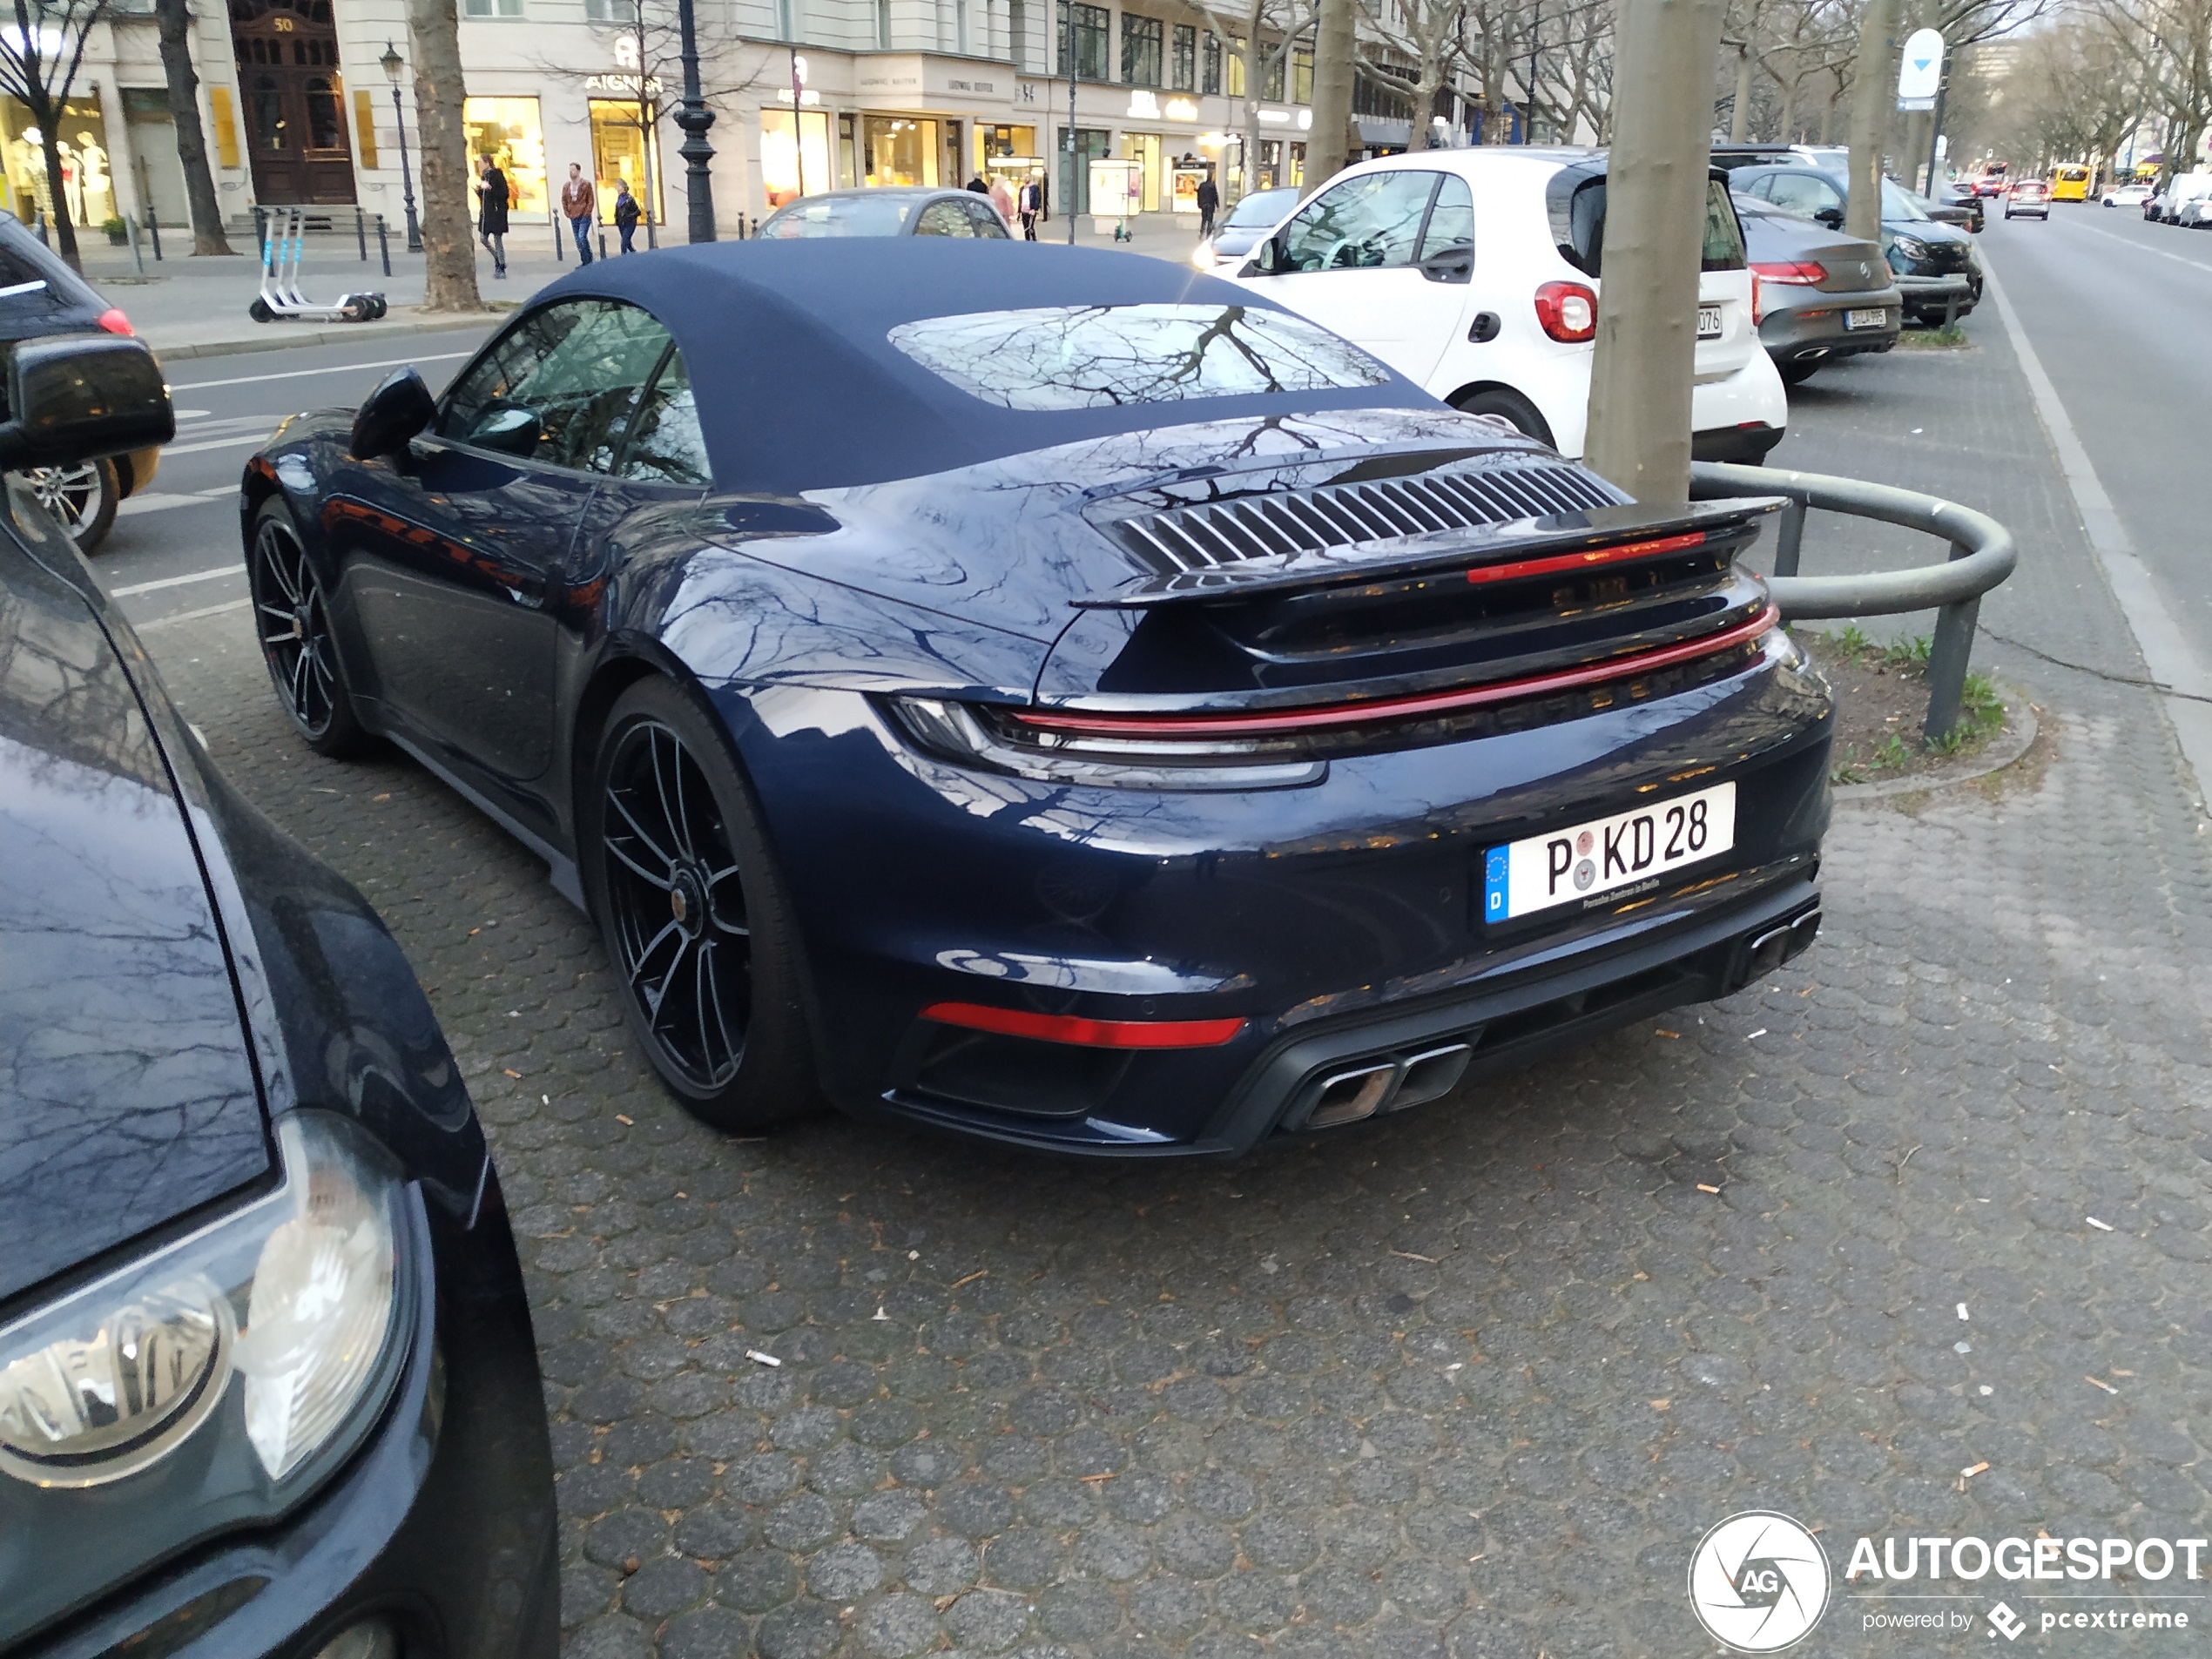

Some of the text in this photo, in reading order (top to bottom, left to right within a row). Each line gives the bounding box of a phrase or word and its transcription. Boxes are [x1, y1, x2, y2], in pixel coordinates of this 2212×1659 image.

[273, 17, 293, 32] 50
[1698, 312, 1720, 331] 076
[1548, 799, 1708, 896] P KD 28
[1490, 892, 1501, 910] D
